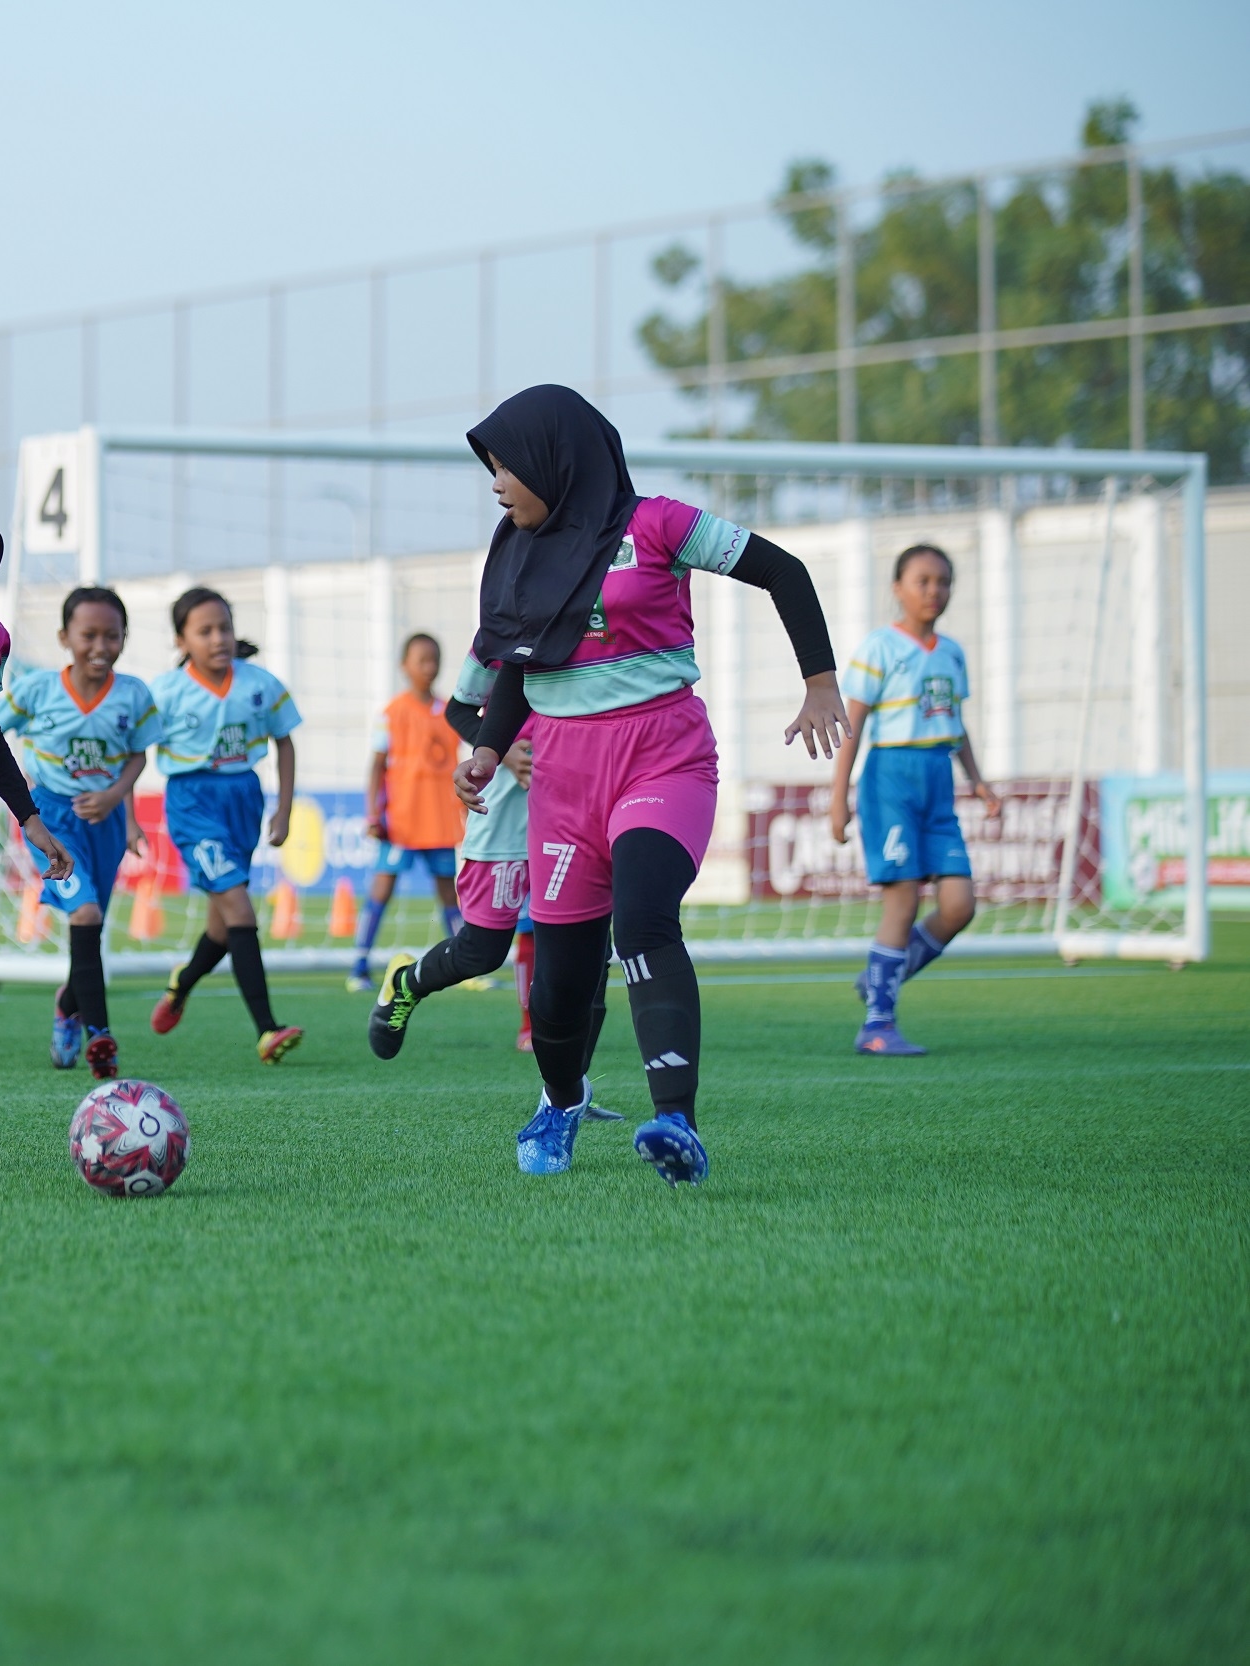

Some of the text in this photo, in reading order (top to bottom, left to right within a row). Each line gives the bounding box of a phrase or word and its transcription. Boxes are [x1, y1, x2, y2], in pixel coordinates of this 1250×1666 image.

[39, 466, 68, 539] 4
[193, 841, 236, 881] 12
[883, 825, 909, 867] 4
[491, 861, 527, 909] 10
[542, 841, 577, 901] 7
